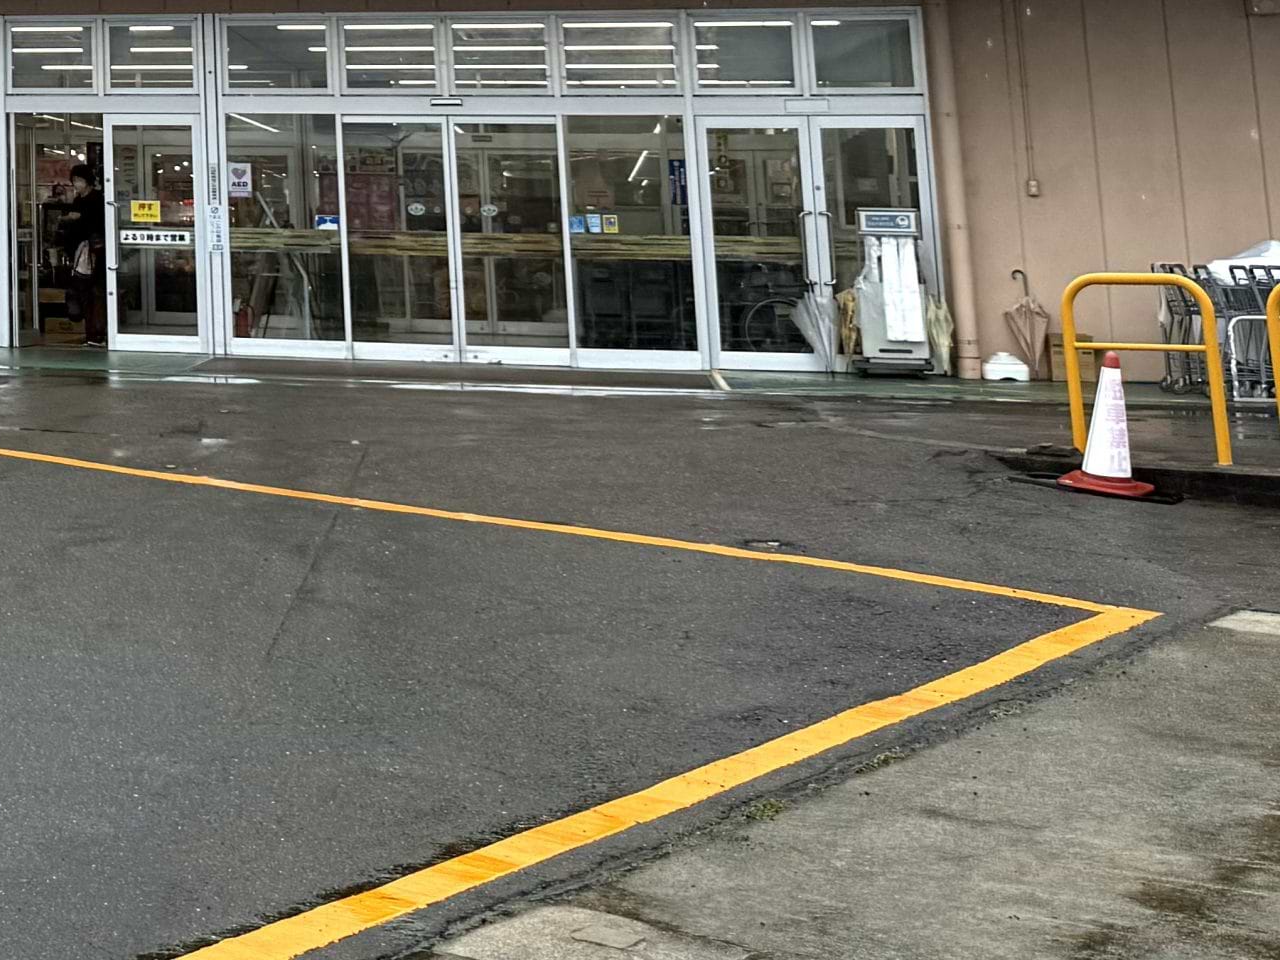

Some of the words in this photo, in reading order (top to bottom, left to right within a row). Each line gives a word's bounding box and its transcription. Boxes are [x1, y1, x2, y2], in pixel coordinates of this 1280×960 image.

[123, 233, 186, 242] よる9時まで営業
